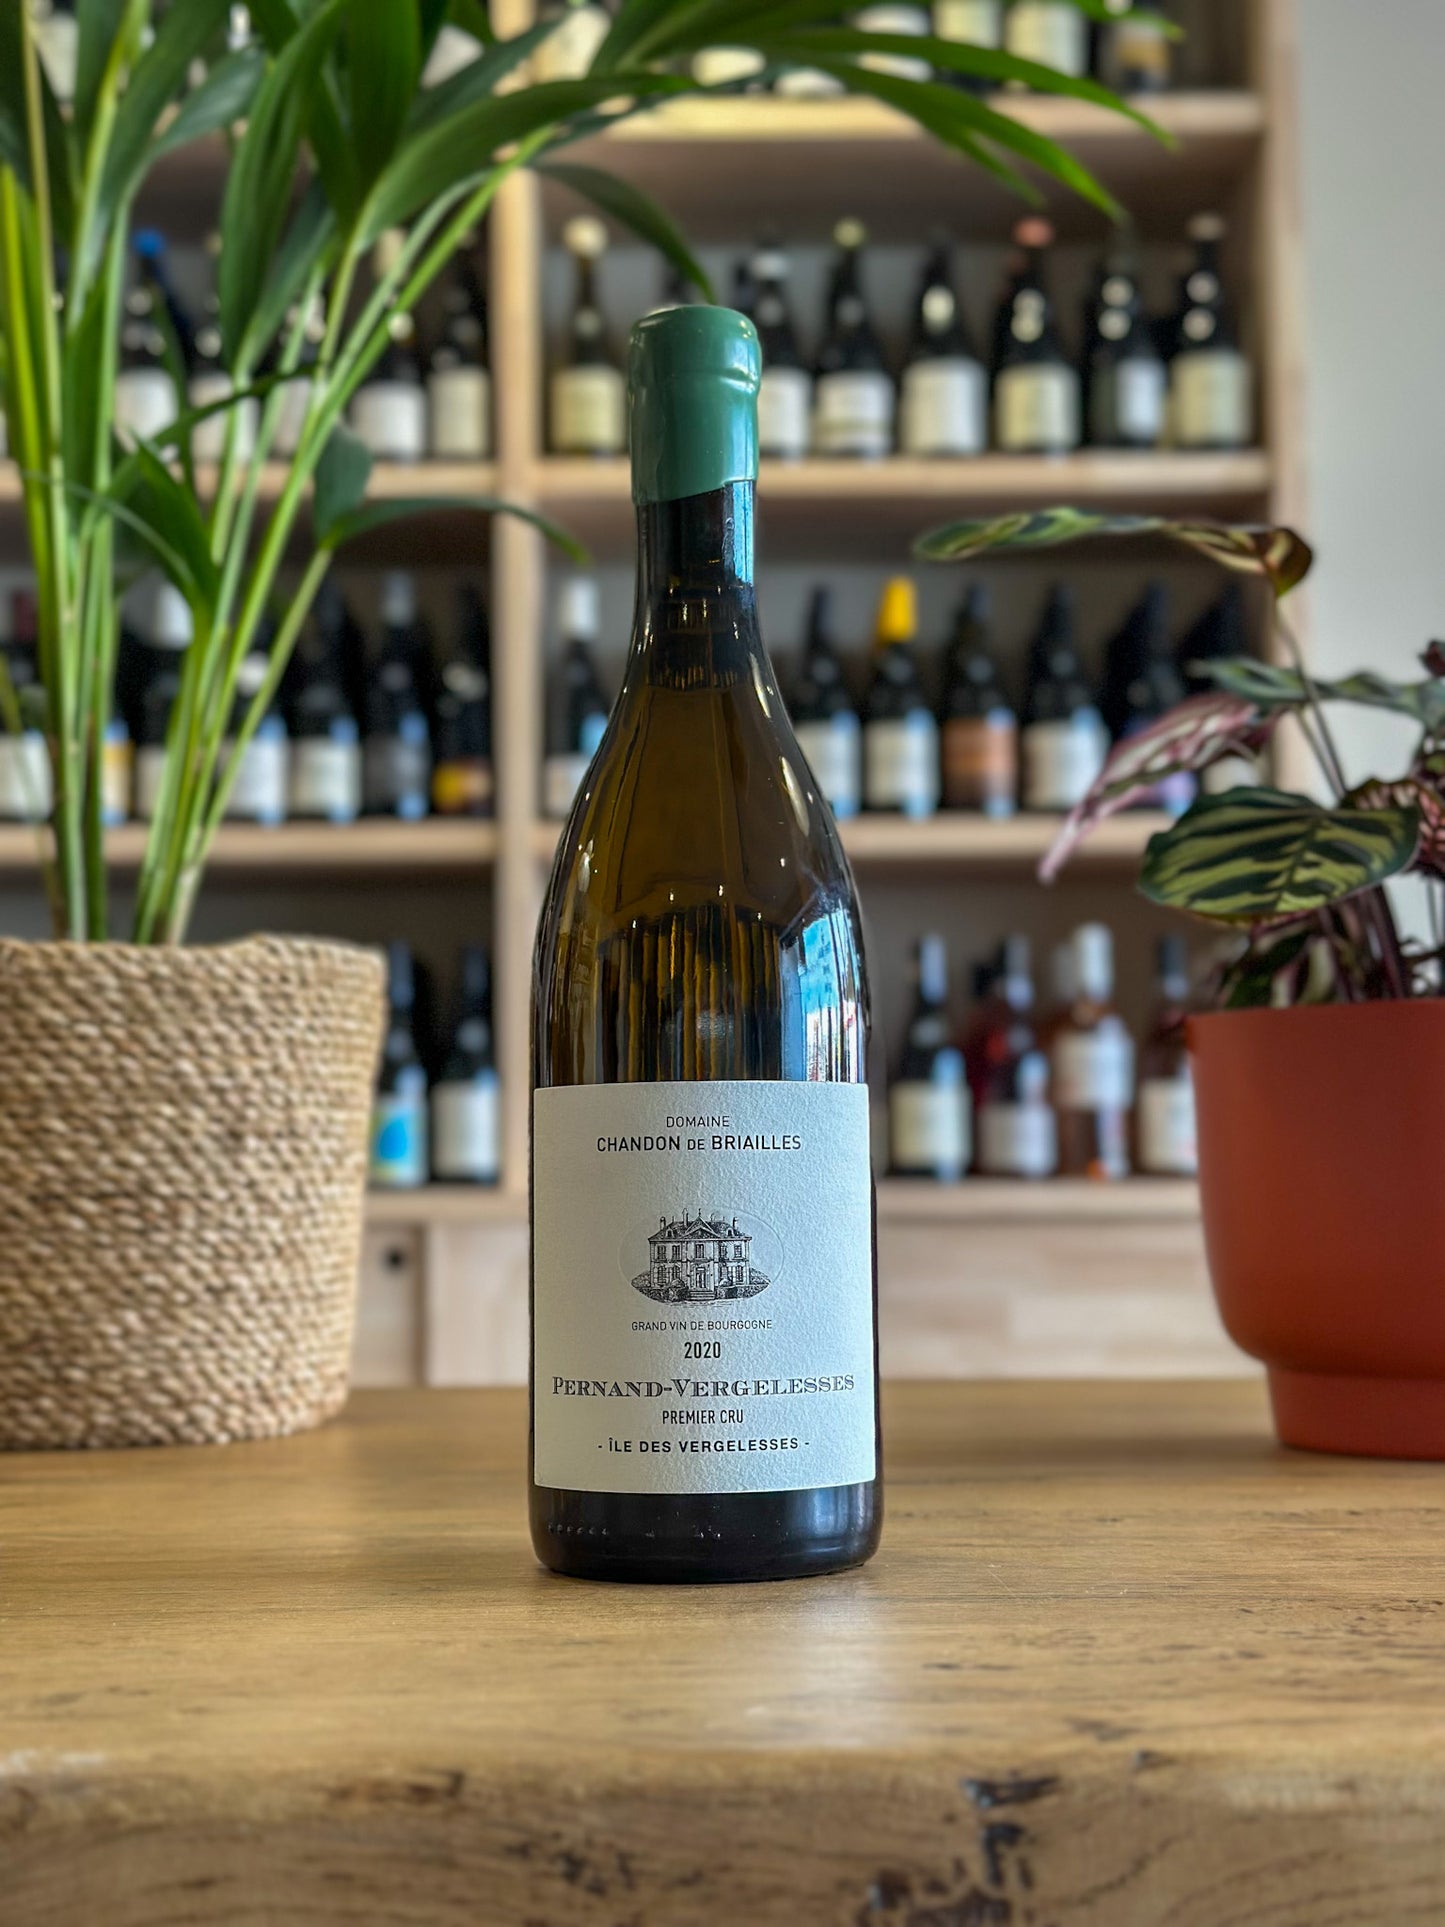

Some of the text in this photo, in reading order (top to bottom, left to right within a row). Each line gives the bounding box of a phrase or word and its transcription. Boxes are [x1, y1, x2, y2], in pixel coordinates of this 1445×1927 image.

[666, 1115, 730, 1128] DOMAINE
[597, 1135, 802, 1152] CHANDON DE BRIAILLES
[631, 1319, 773, 1331] GRAND VIN DE BOURGOGNE
[684, 1341, 722, 1359] 2020
[662, 1409, 744, 1425] PREMIER CRU
[609, 1437, 633, 1453] ÎLE
[639, 1440, 671, 1453] DES
[679, 1437, 799, 1453] VERGELESSES
